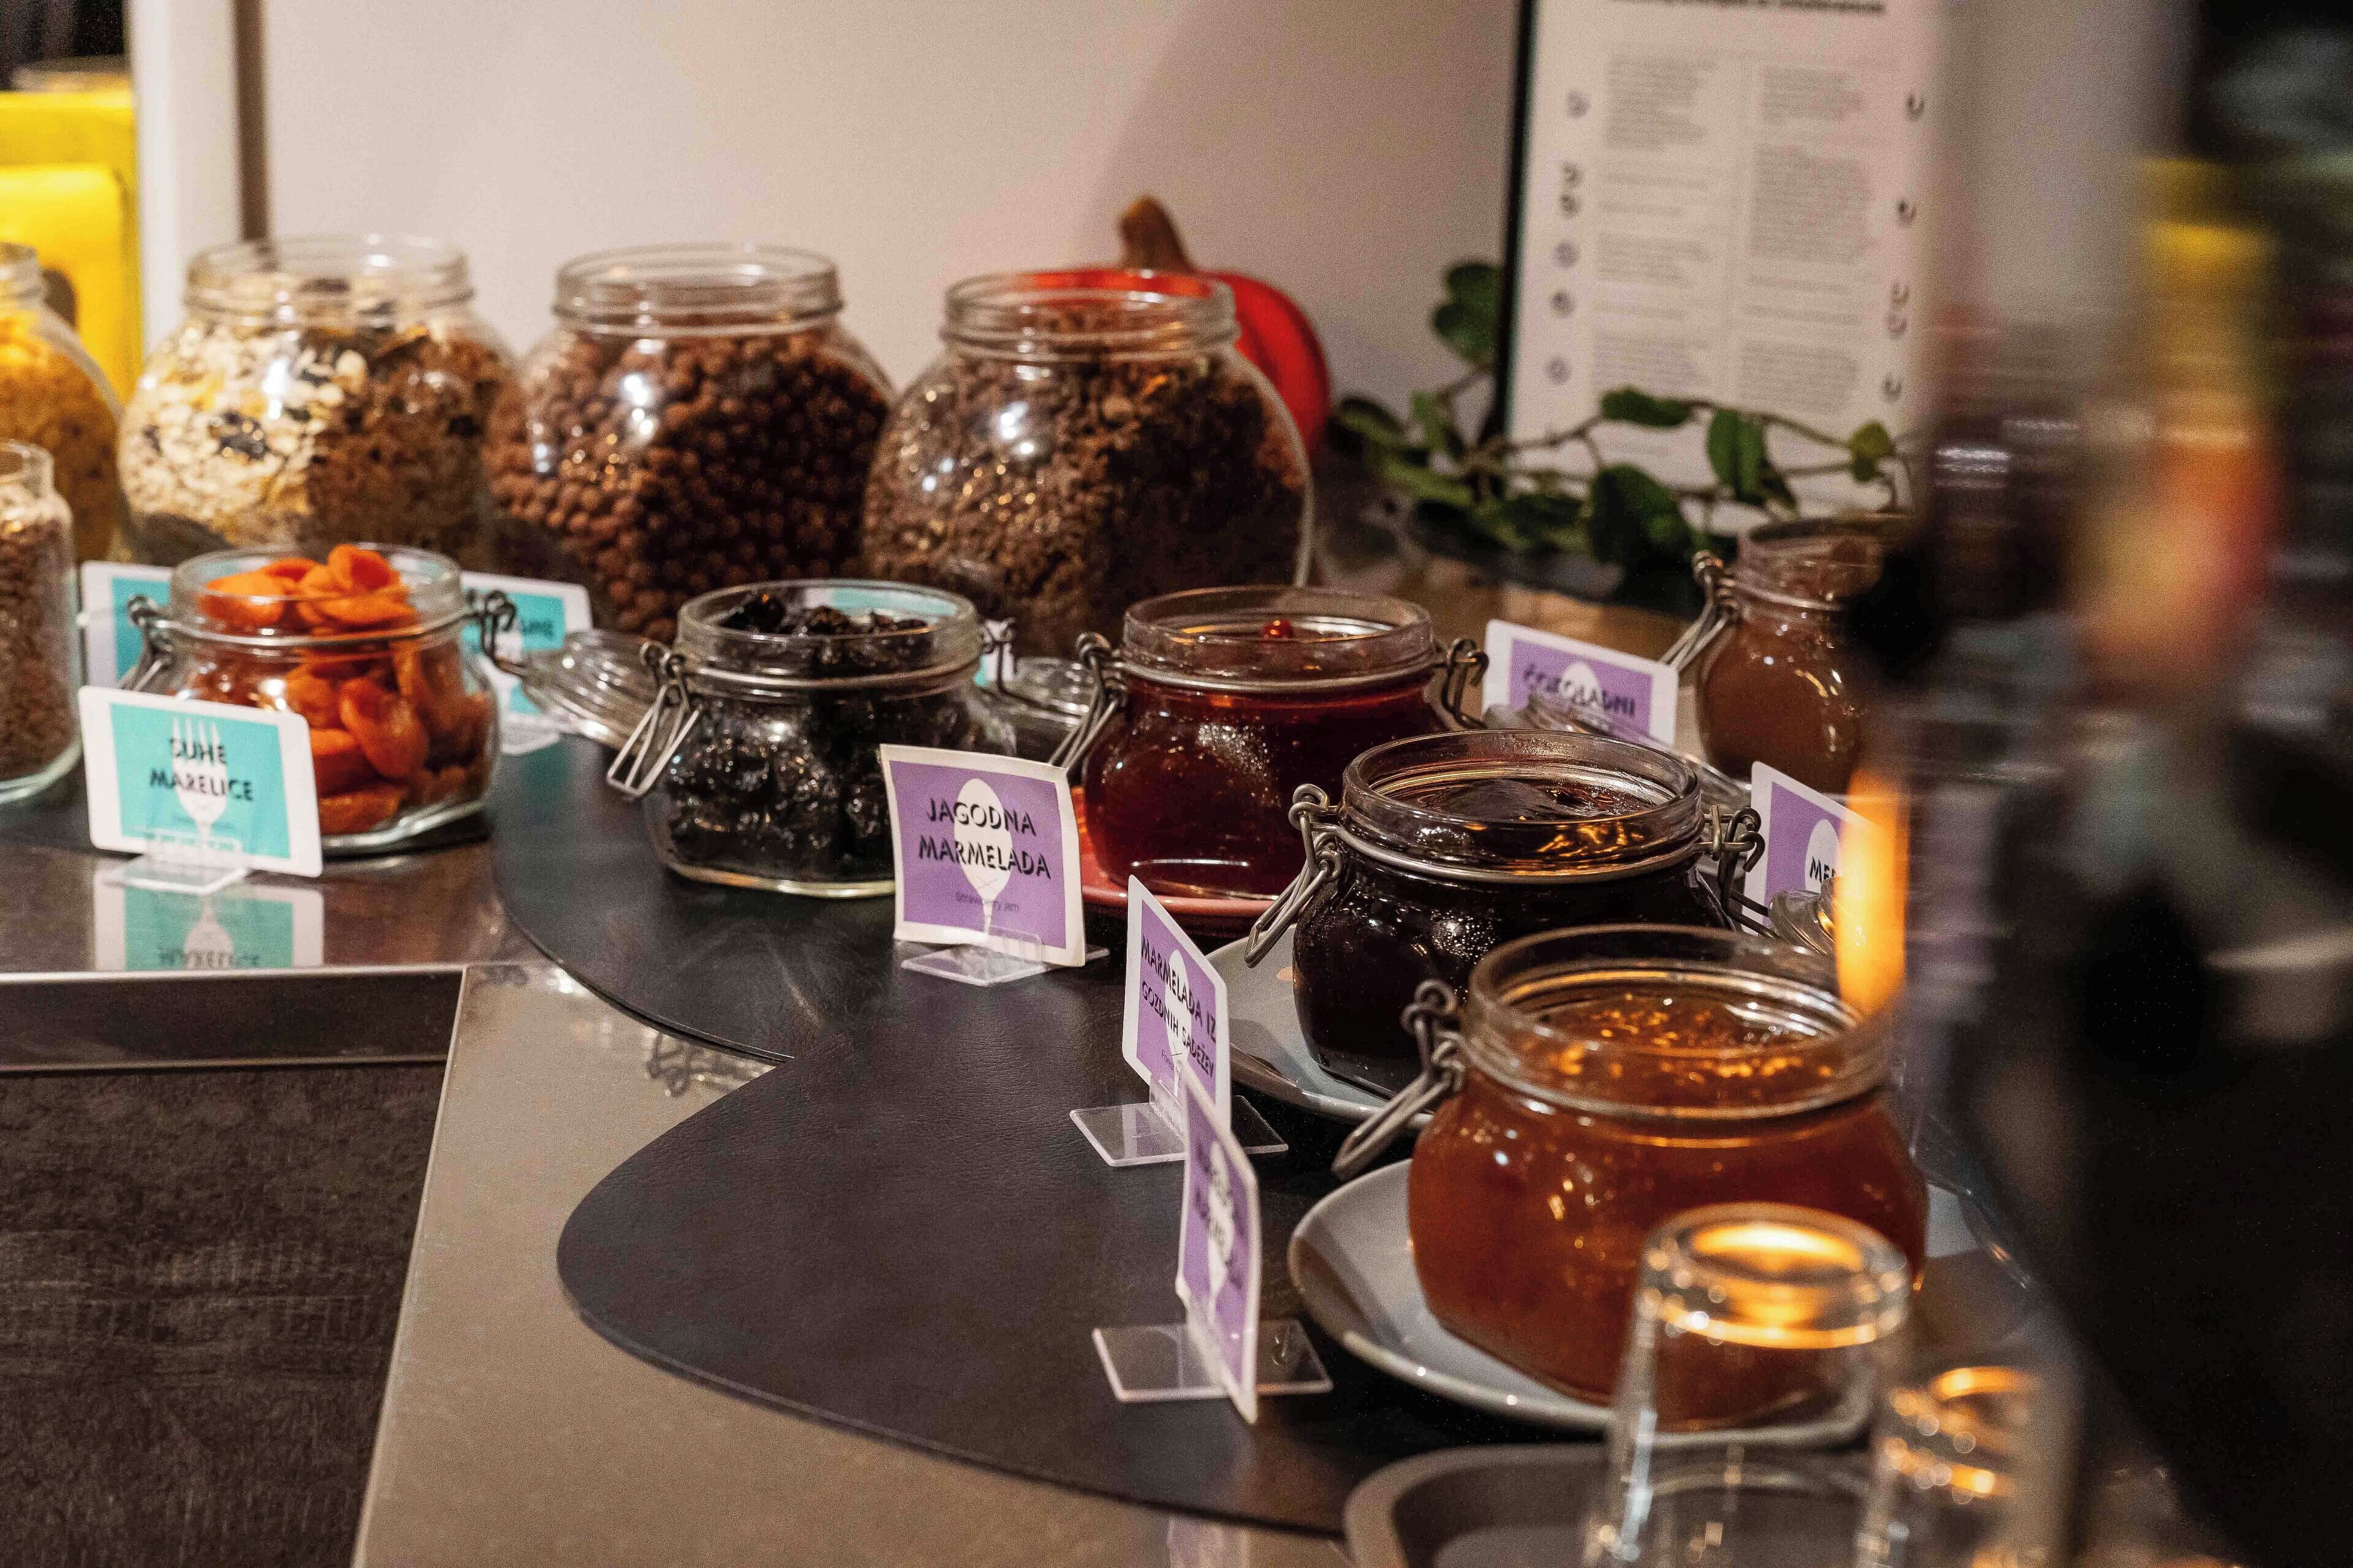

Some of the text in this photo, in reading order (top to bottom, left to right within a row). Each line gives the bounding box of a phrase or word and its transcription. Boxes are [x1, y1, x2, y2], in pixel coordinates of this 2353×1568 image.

[149, 769, 254, 802] MARELICE
[926, 798, 1037, 838] JAGODNA
[918, 835, 1052, 880] MARMELADA
[1809, 855, 1837, 884] ME
[1141, 934, 1216, 1045] MARMELADA IZ
[1142, 980, 1179, 1038] GOZDNIH
